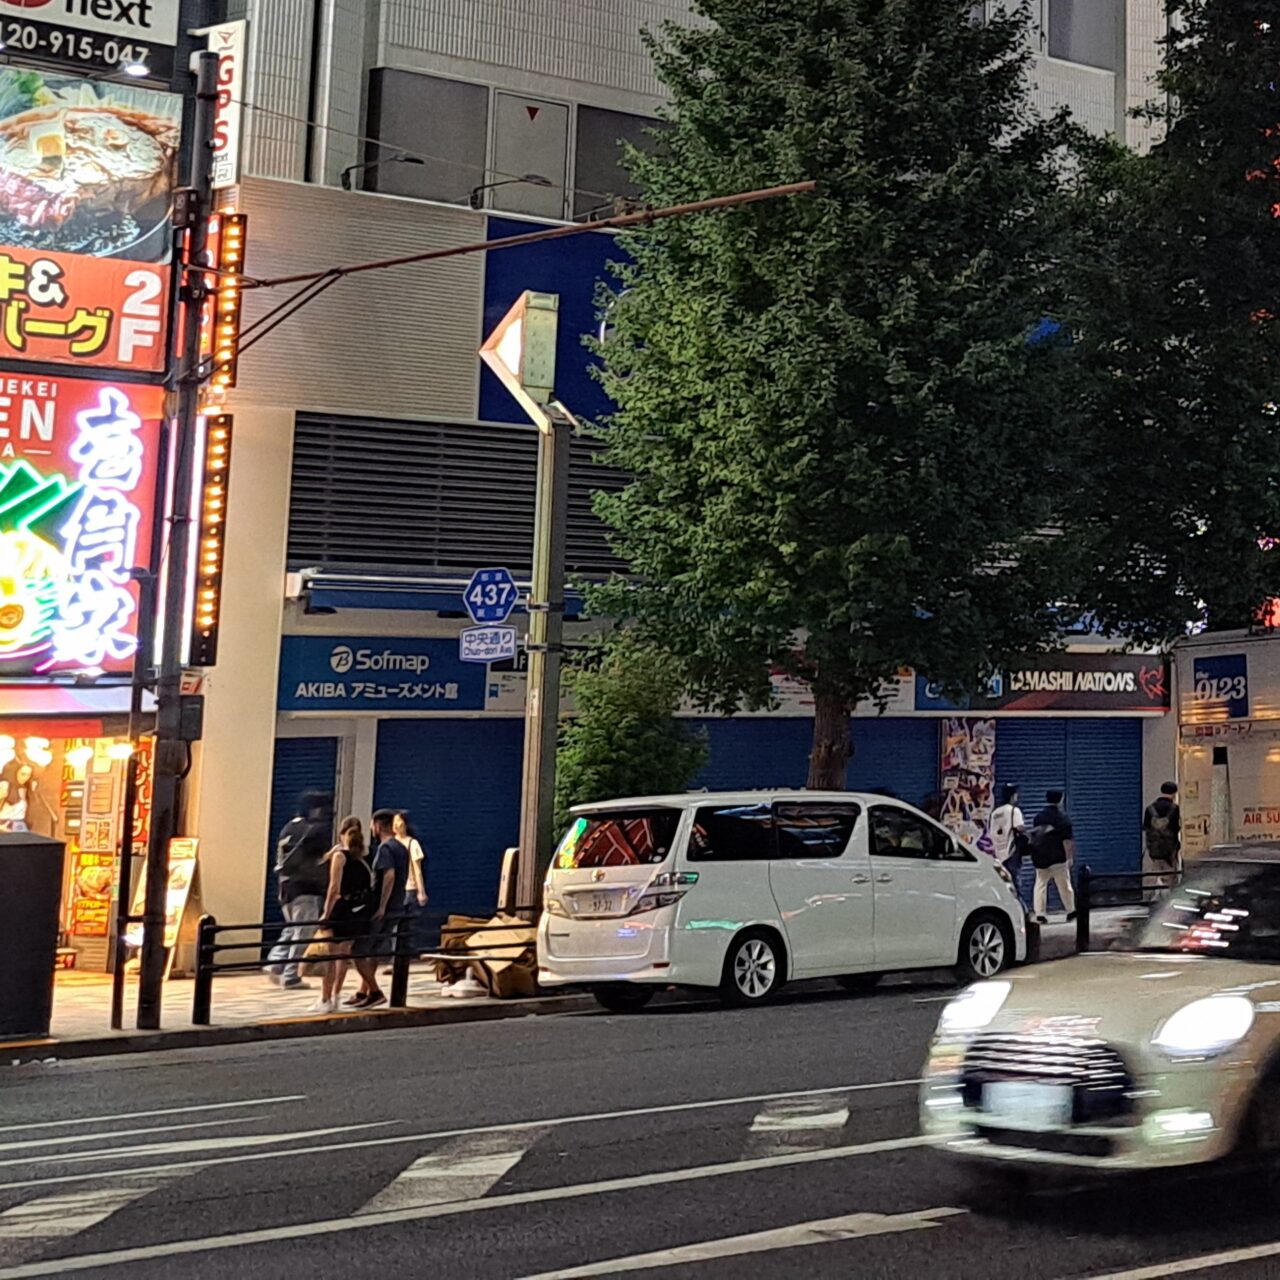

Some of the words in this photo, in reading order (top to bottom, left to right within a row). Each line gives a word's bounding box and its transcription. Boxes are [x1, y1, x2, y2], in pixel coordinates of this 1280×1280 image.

[206, 54, 235, 152] GPS
[469, 584, 512, 606] 437
[464, 631, 512, 646] 中央通り
[356, 650, 430, 675] Sofmap
[295, 682, 347, 699] AKIBA
[351, 683, 459, 700] アミューズメント館
[1195, 679, 1247, 702] 0123
[1243, 812, 1262, 825] AIR
